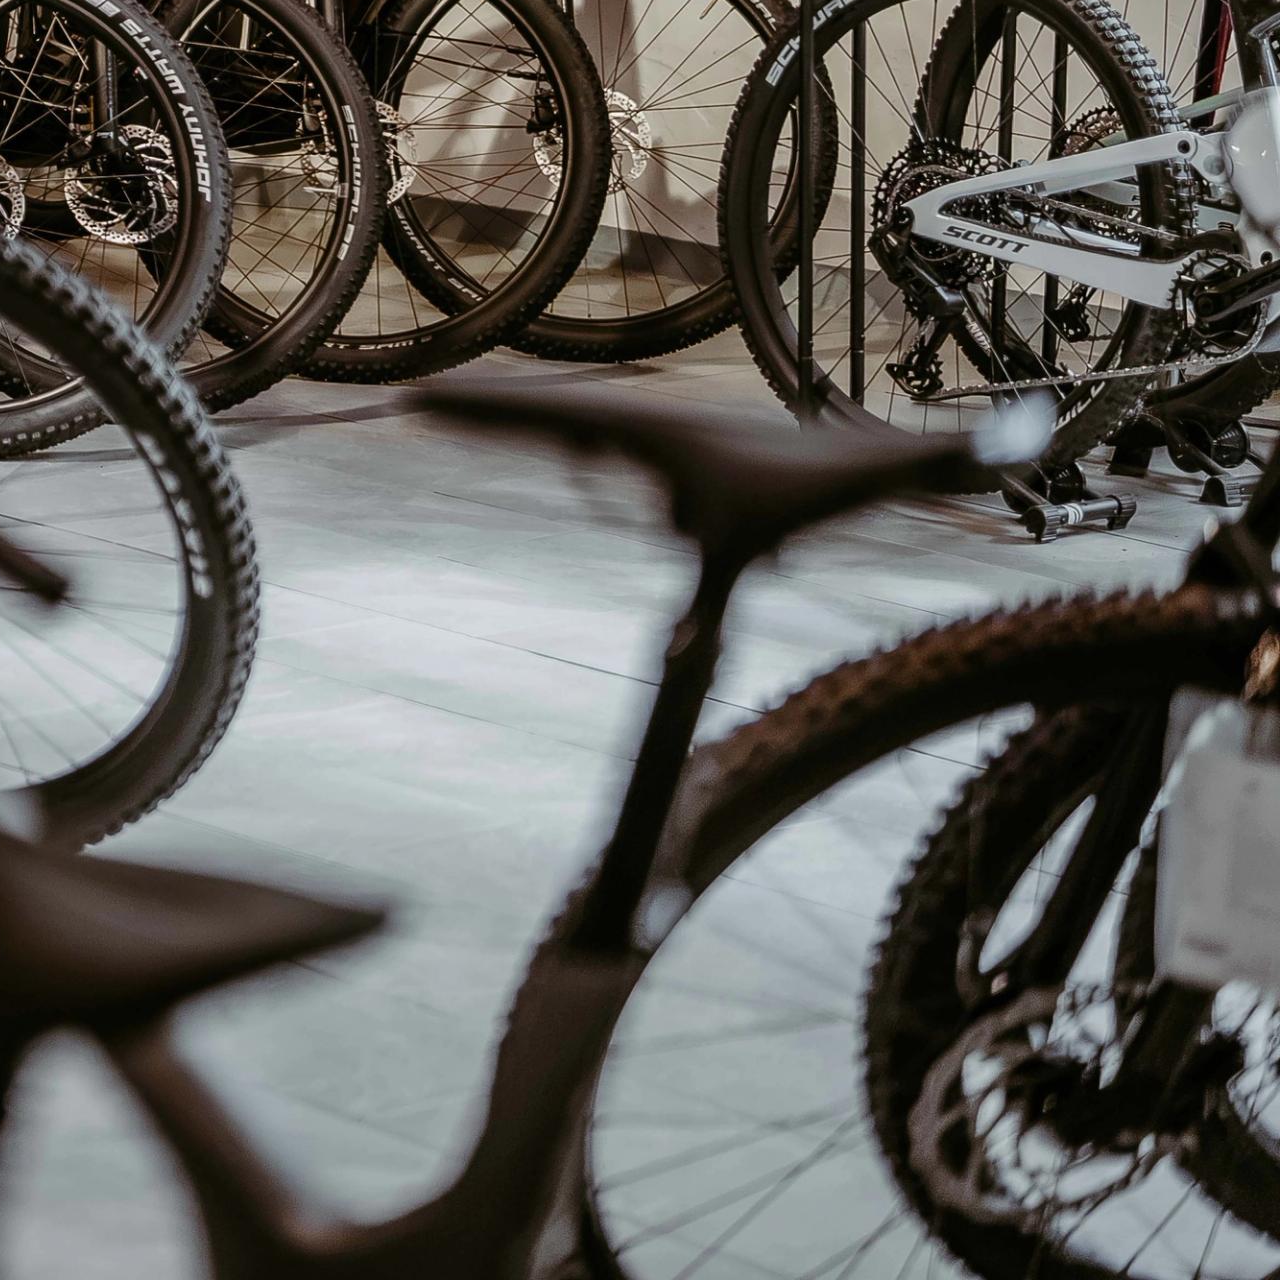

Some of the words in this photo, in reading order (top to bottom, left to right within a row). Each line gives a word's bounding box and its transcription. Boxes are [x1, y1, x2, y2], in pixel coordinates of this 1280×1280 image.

[119, 18, 186, 95] WATTS
[177, 102, 212, 202] JOHNNY
[338, 103, 362, 262] SCHWALBE
[942, 224, 1030, 254] SCOTT
